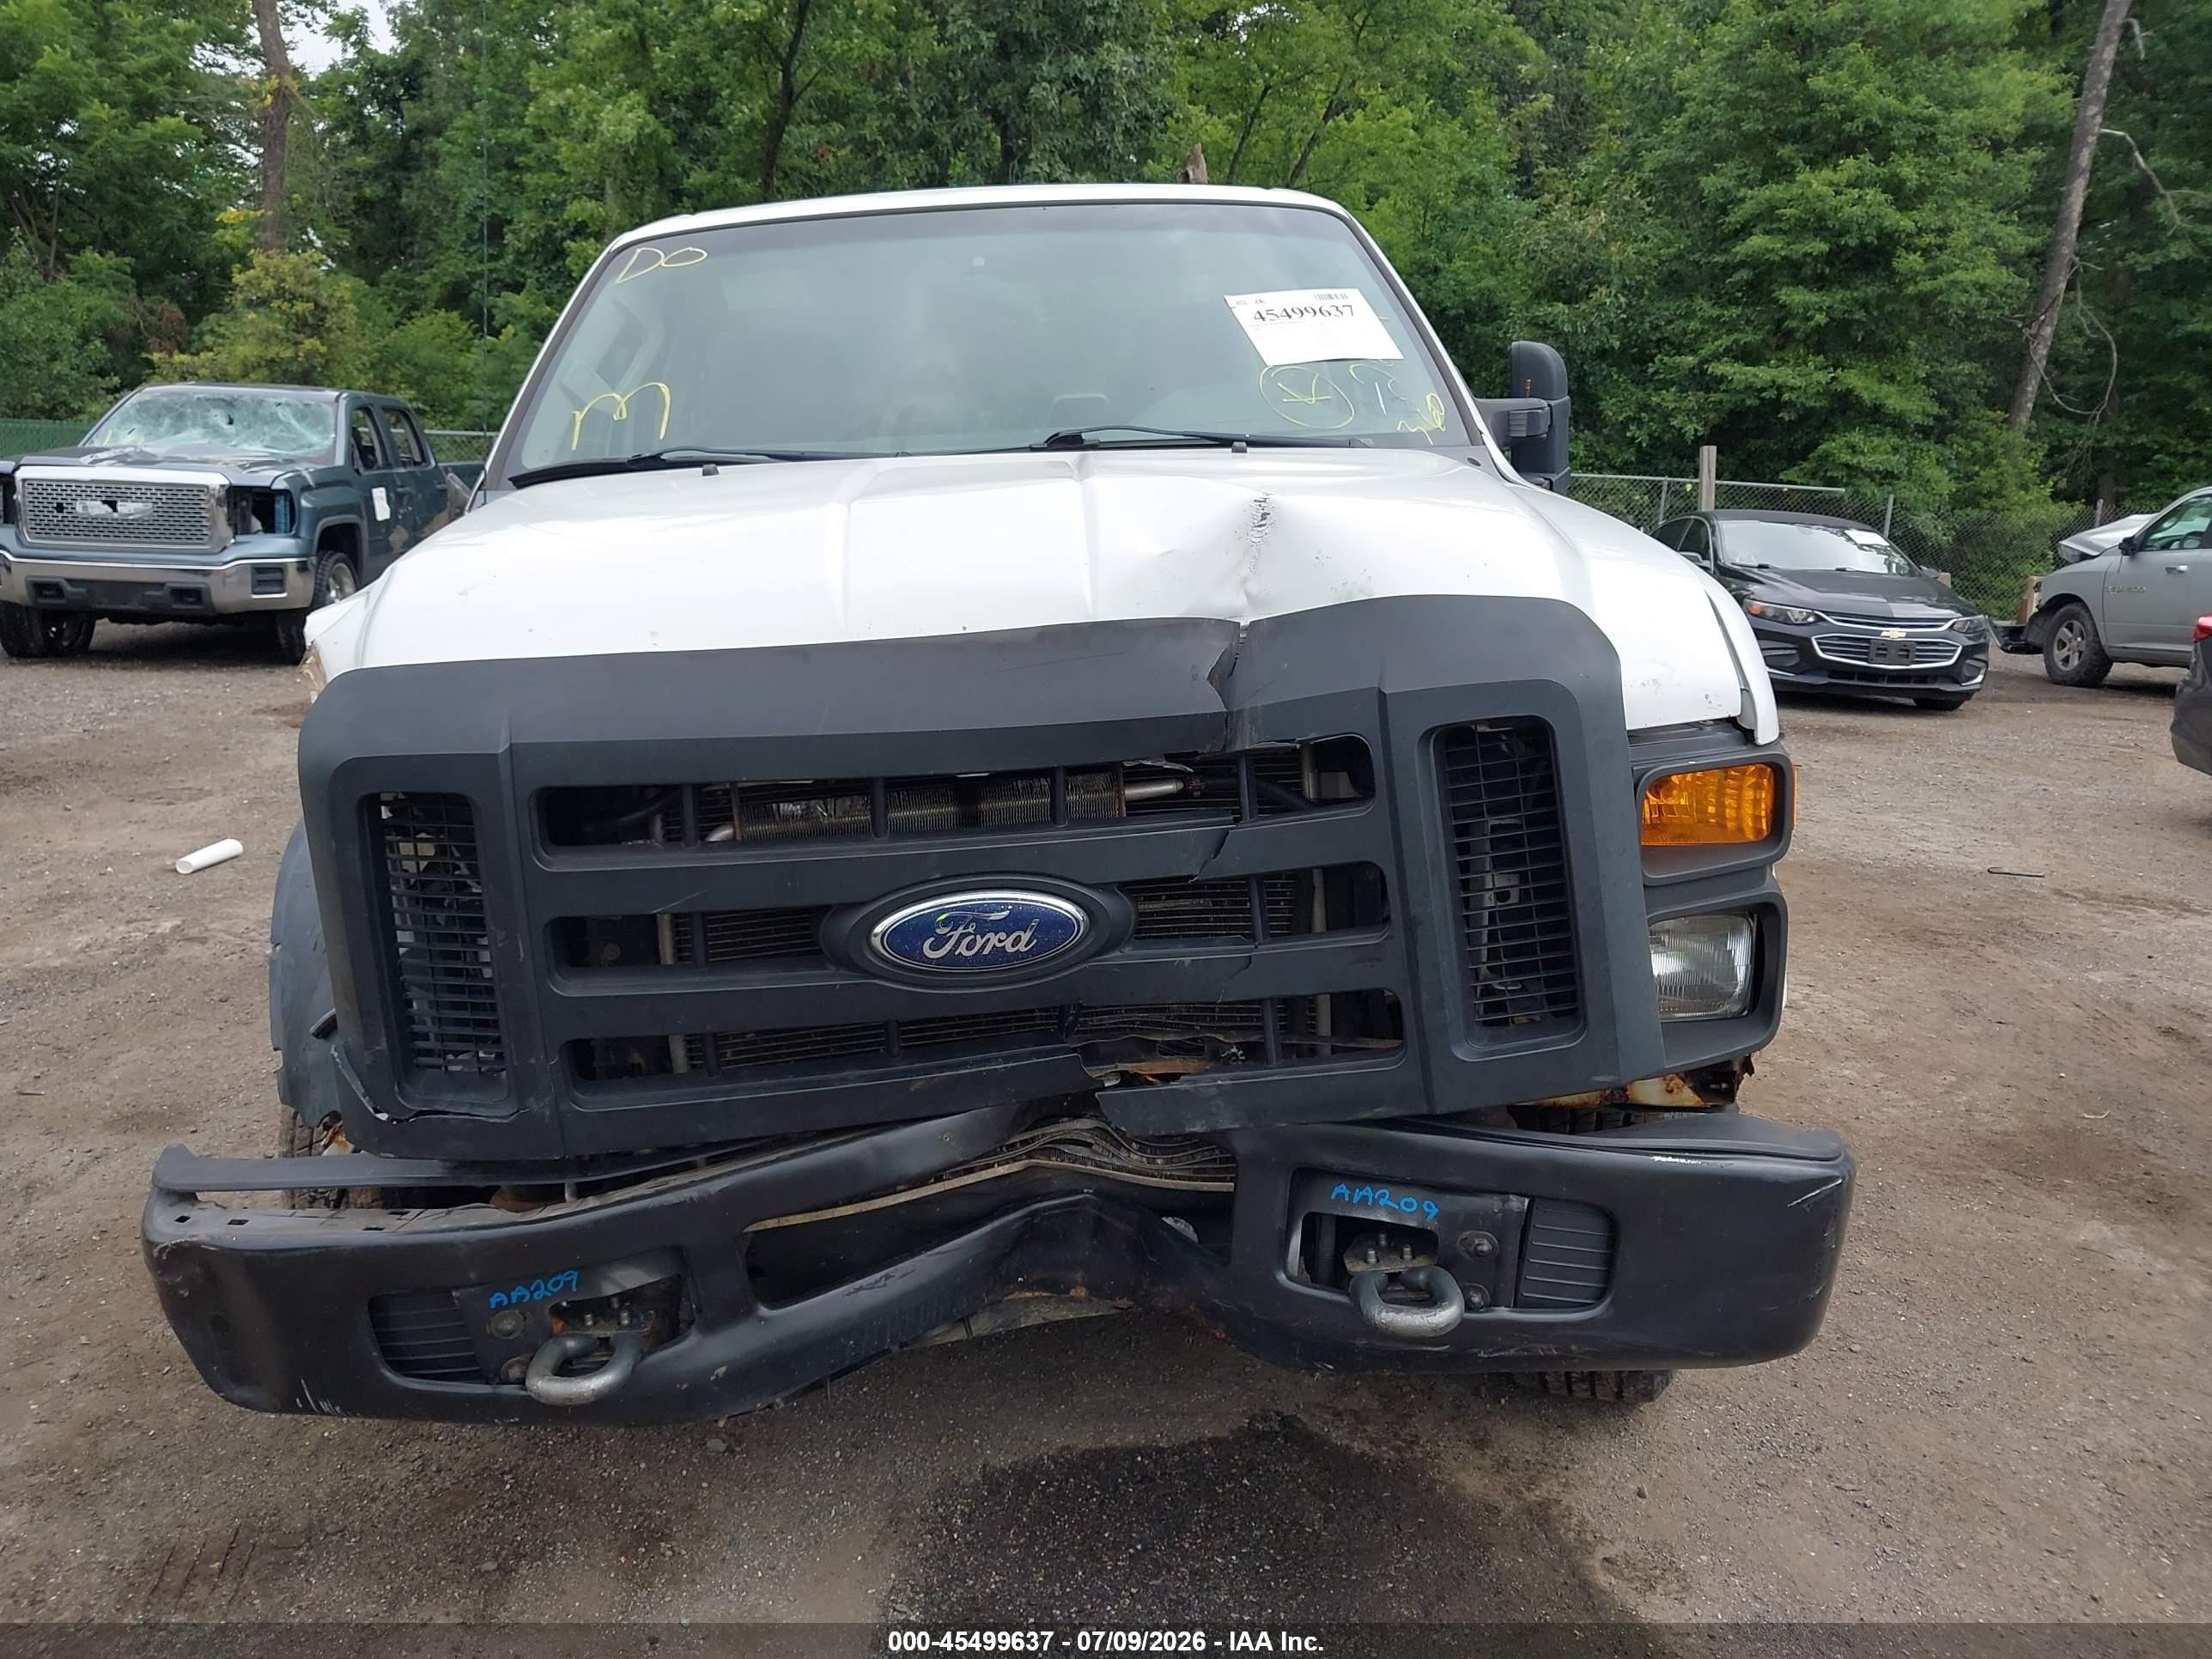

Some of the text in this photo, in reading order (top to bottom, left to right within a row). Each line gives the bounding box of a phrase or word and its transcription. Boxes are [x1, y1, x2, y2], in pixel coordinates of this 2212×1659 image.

[1254, 304, 1354, 322] 45499637
[922, 910, 1039, 958] Ford
[489, 1270, 579, 1309] AA209
